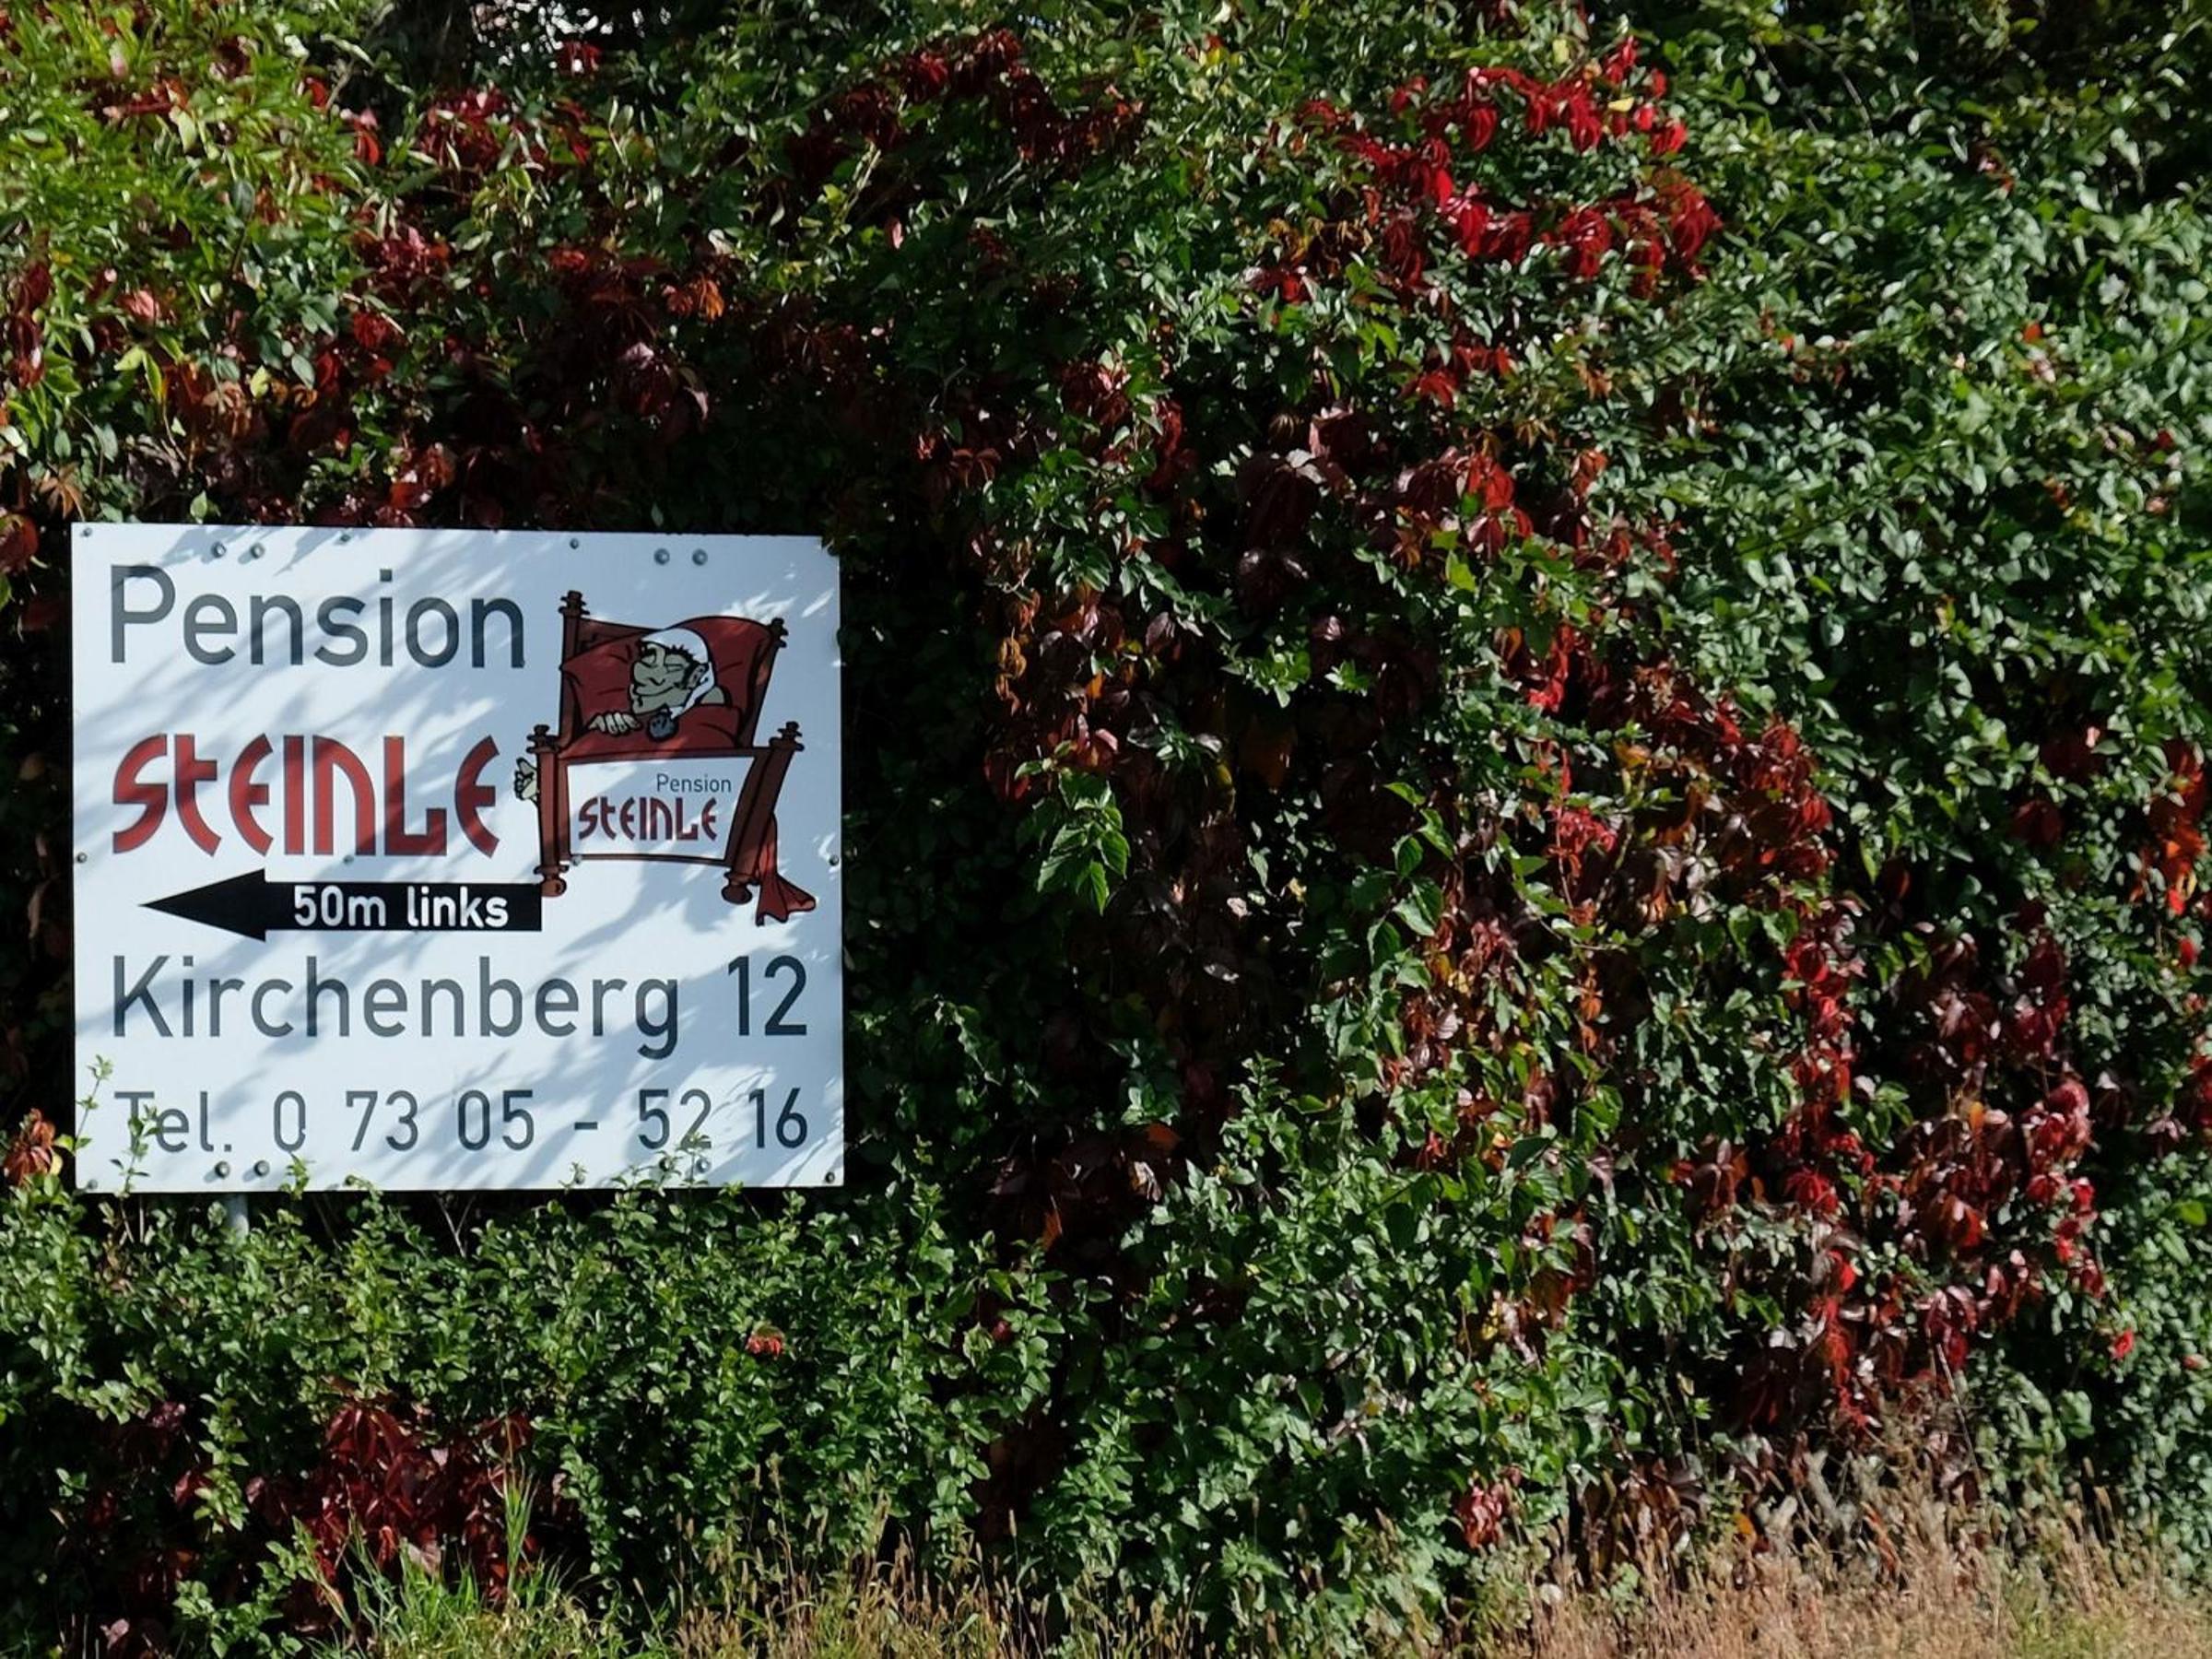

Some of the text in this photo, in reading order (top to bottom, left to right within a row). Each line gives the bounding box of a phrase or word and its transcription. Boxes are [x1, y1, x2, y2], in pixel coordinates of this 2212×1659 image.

[111, 564, 524, 669] Pension
[656, 773, 732, 794] Pension
[293, 885, 509, 928] 50m links
[112, 954, 808, 1060] Kirchenberg 12
[114, 1090, 232, 1153] Tel.
[273, 1089, 307, 1152] 0
[346, 1089, 418, 1151] 73
[457, 1088, 535, 1151] 05
[637, 1088, 712, 1150] 52
[747, 1087, 808, 1149] 16
